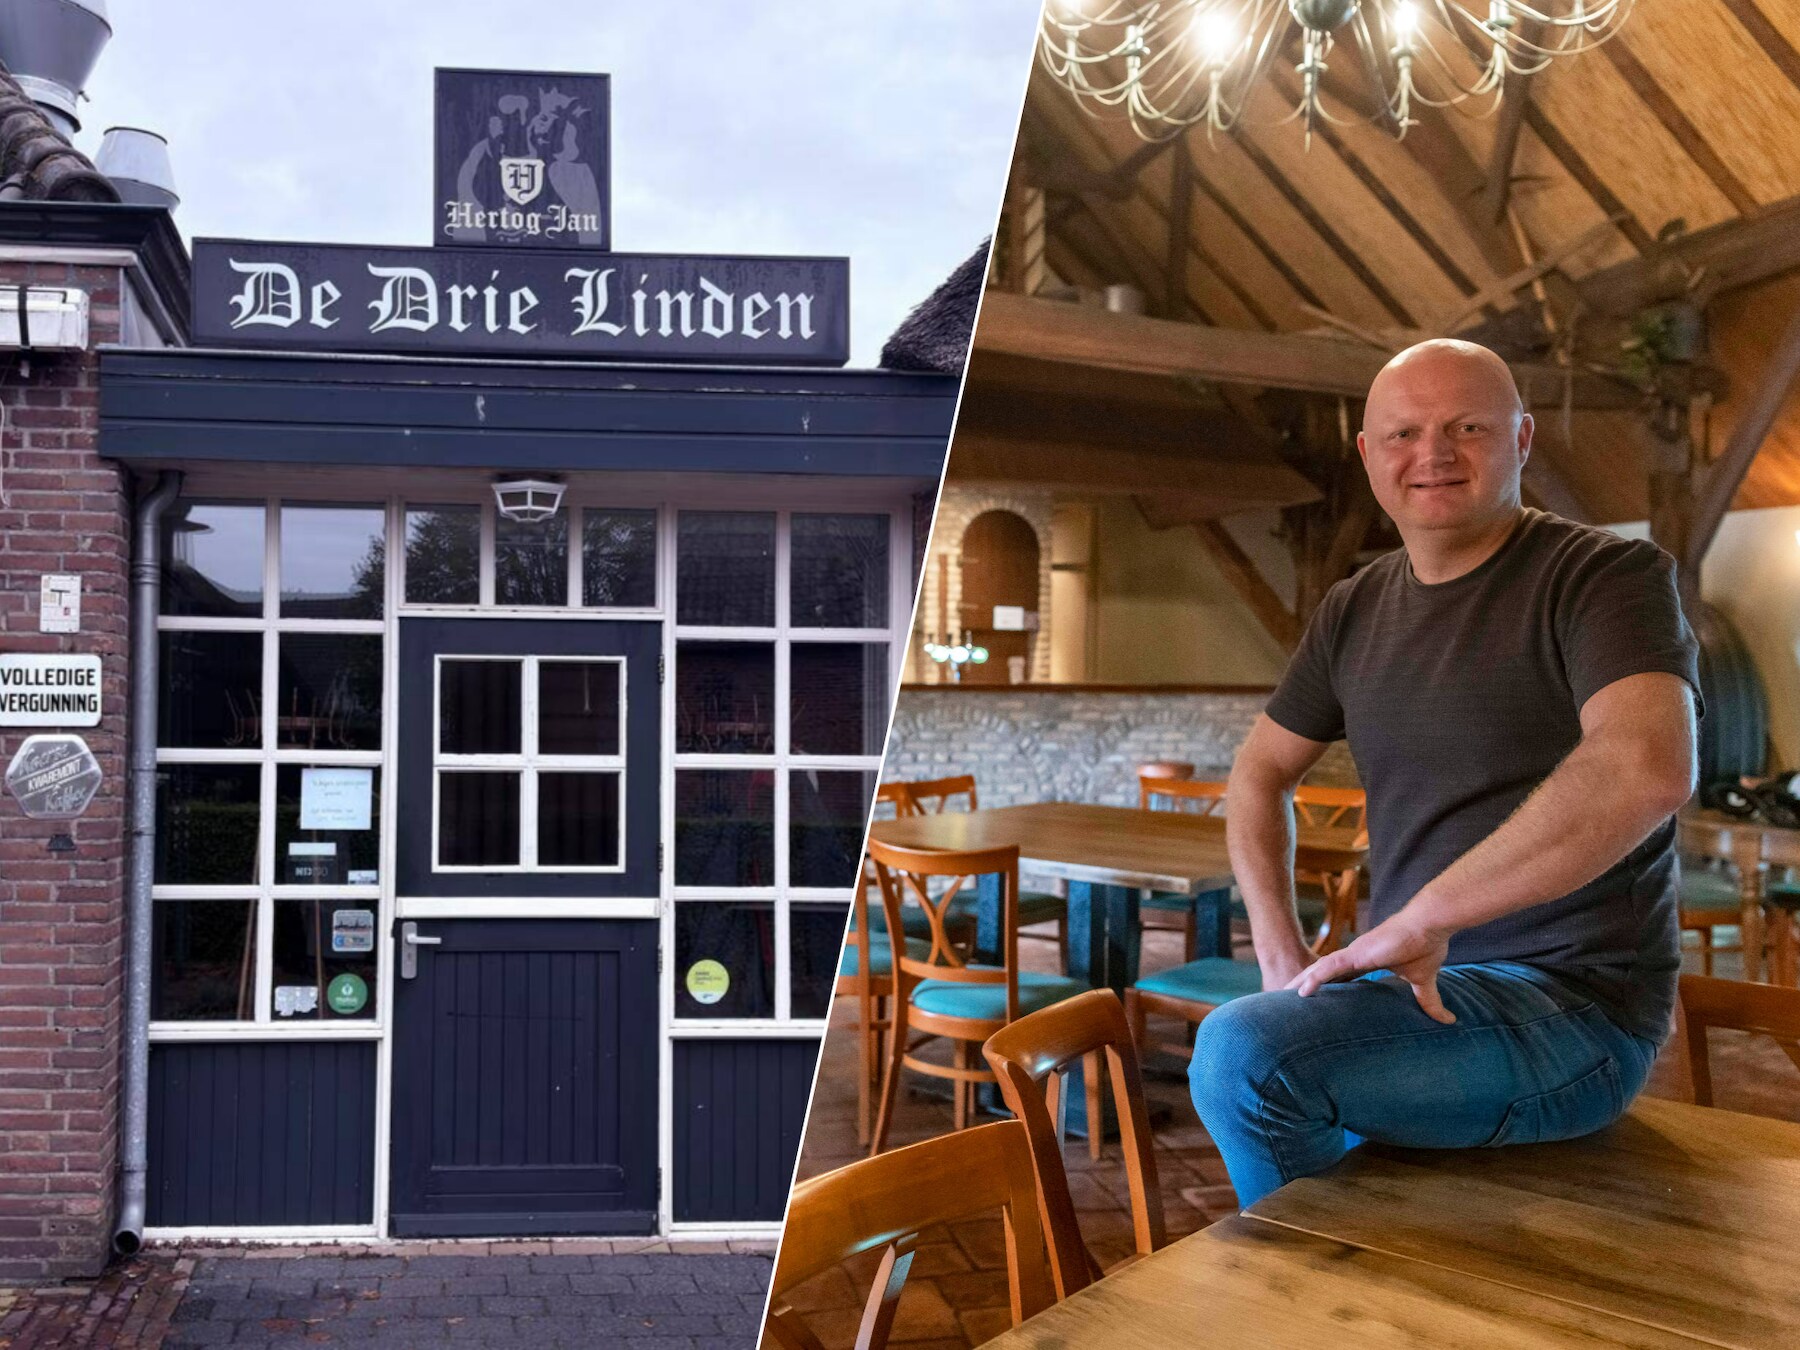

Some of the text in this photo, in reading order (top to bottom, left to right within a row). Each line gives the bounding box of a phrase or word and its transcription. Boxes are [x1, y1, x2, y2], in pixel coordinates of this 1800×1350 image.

[444, 201, 599, 239] Hertog Jan
[229, 257, 816, 340] De Drie Linden
[0, 668, 96, 686] VOLLEDIGE
[0, 693, 98, 713] VERGUNNING
